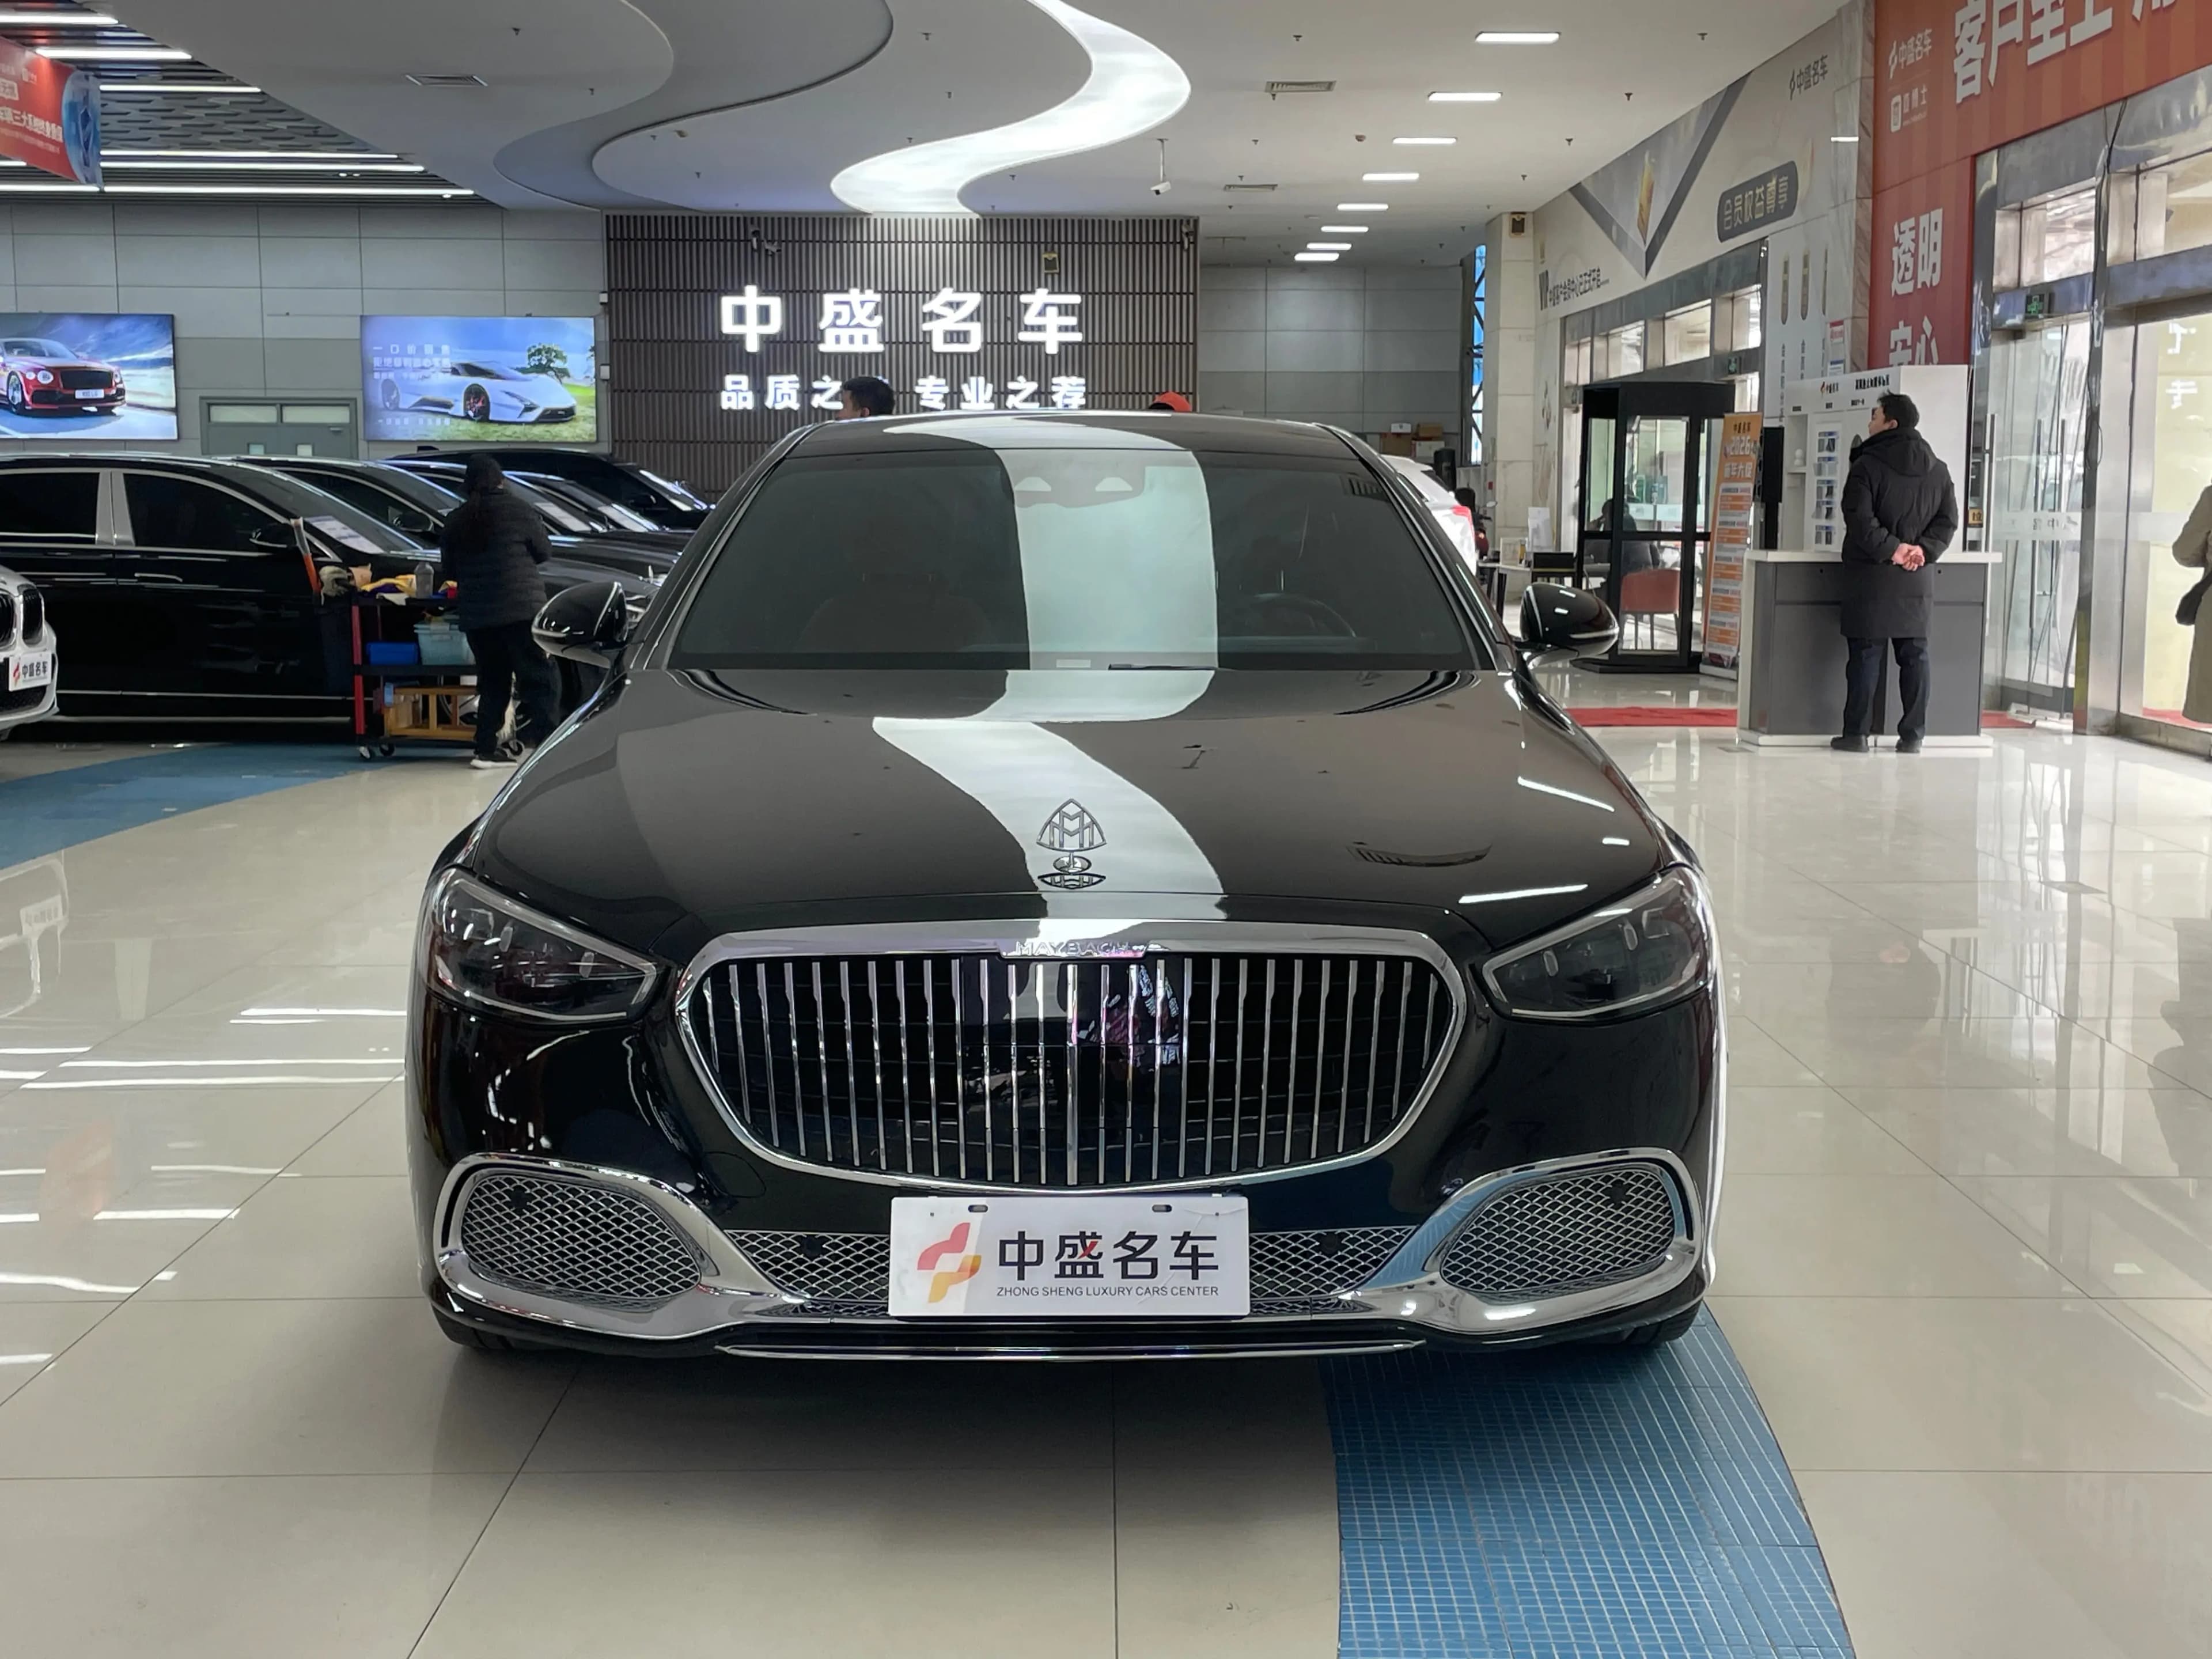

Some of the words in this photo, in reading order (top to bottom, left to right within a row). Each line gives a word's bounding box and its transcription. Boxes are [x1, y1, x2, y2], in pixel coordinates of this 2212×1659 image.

[1892, 208, 1943, 297] 透明
[721, 285, 1084, 355] 中盛名车
[721, 374, 891, 410] 品质之
[1016, 941, 1128, 956] MAYBACH
[998, 1230, 1219, 1281] 中盛名车
[997, 1286, 1039, 1296] ZHONG
[1041, 1286, 1084, 1296] SHENG
[1085, 1286, 1133, 1296] LUXURY
[1135, 1286, 1168, 1296] CARS
[1170, 1286, 1219, 1296] CENTER
